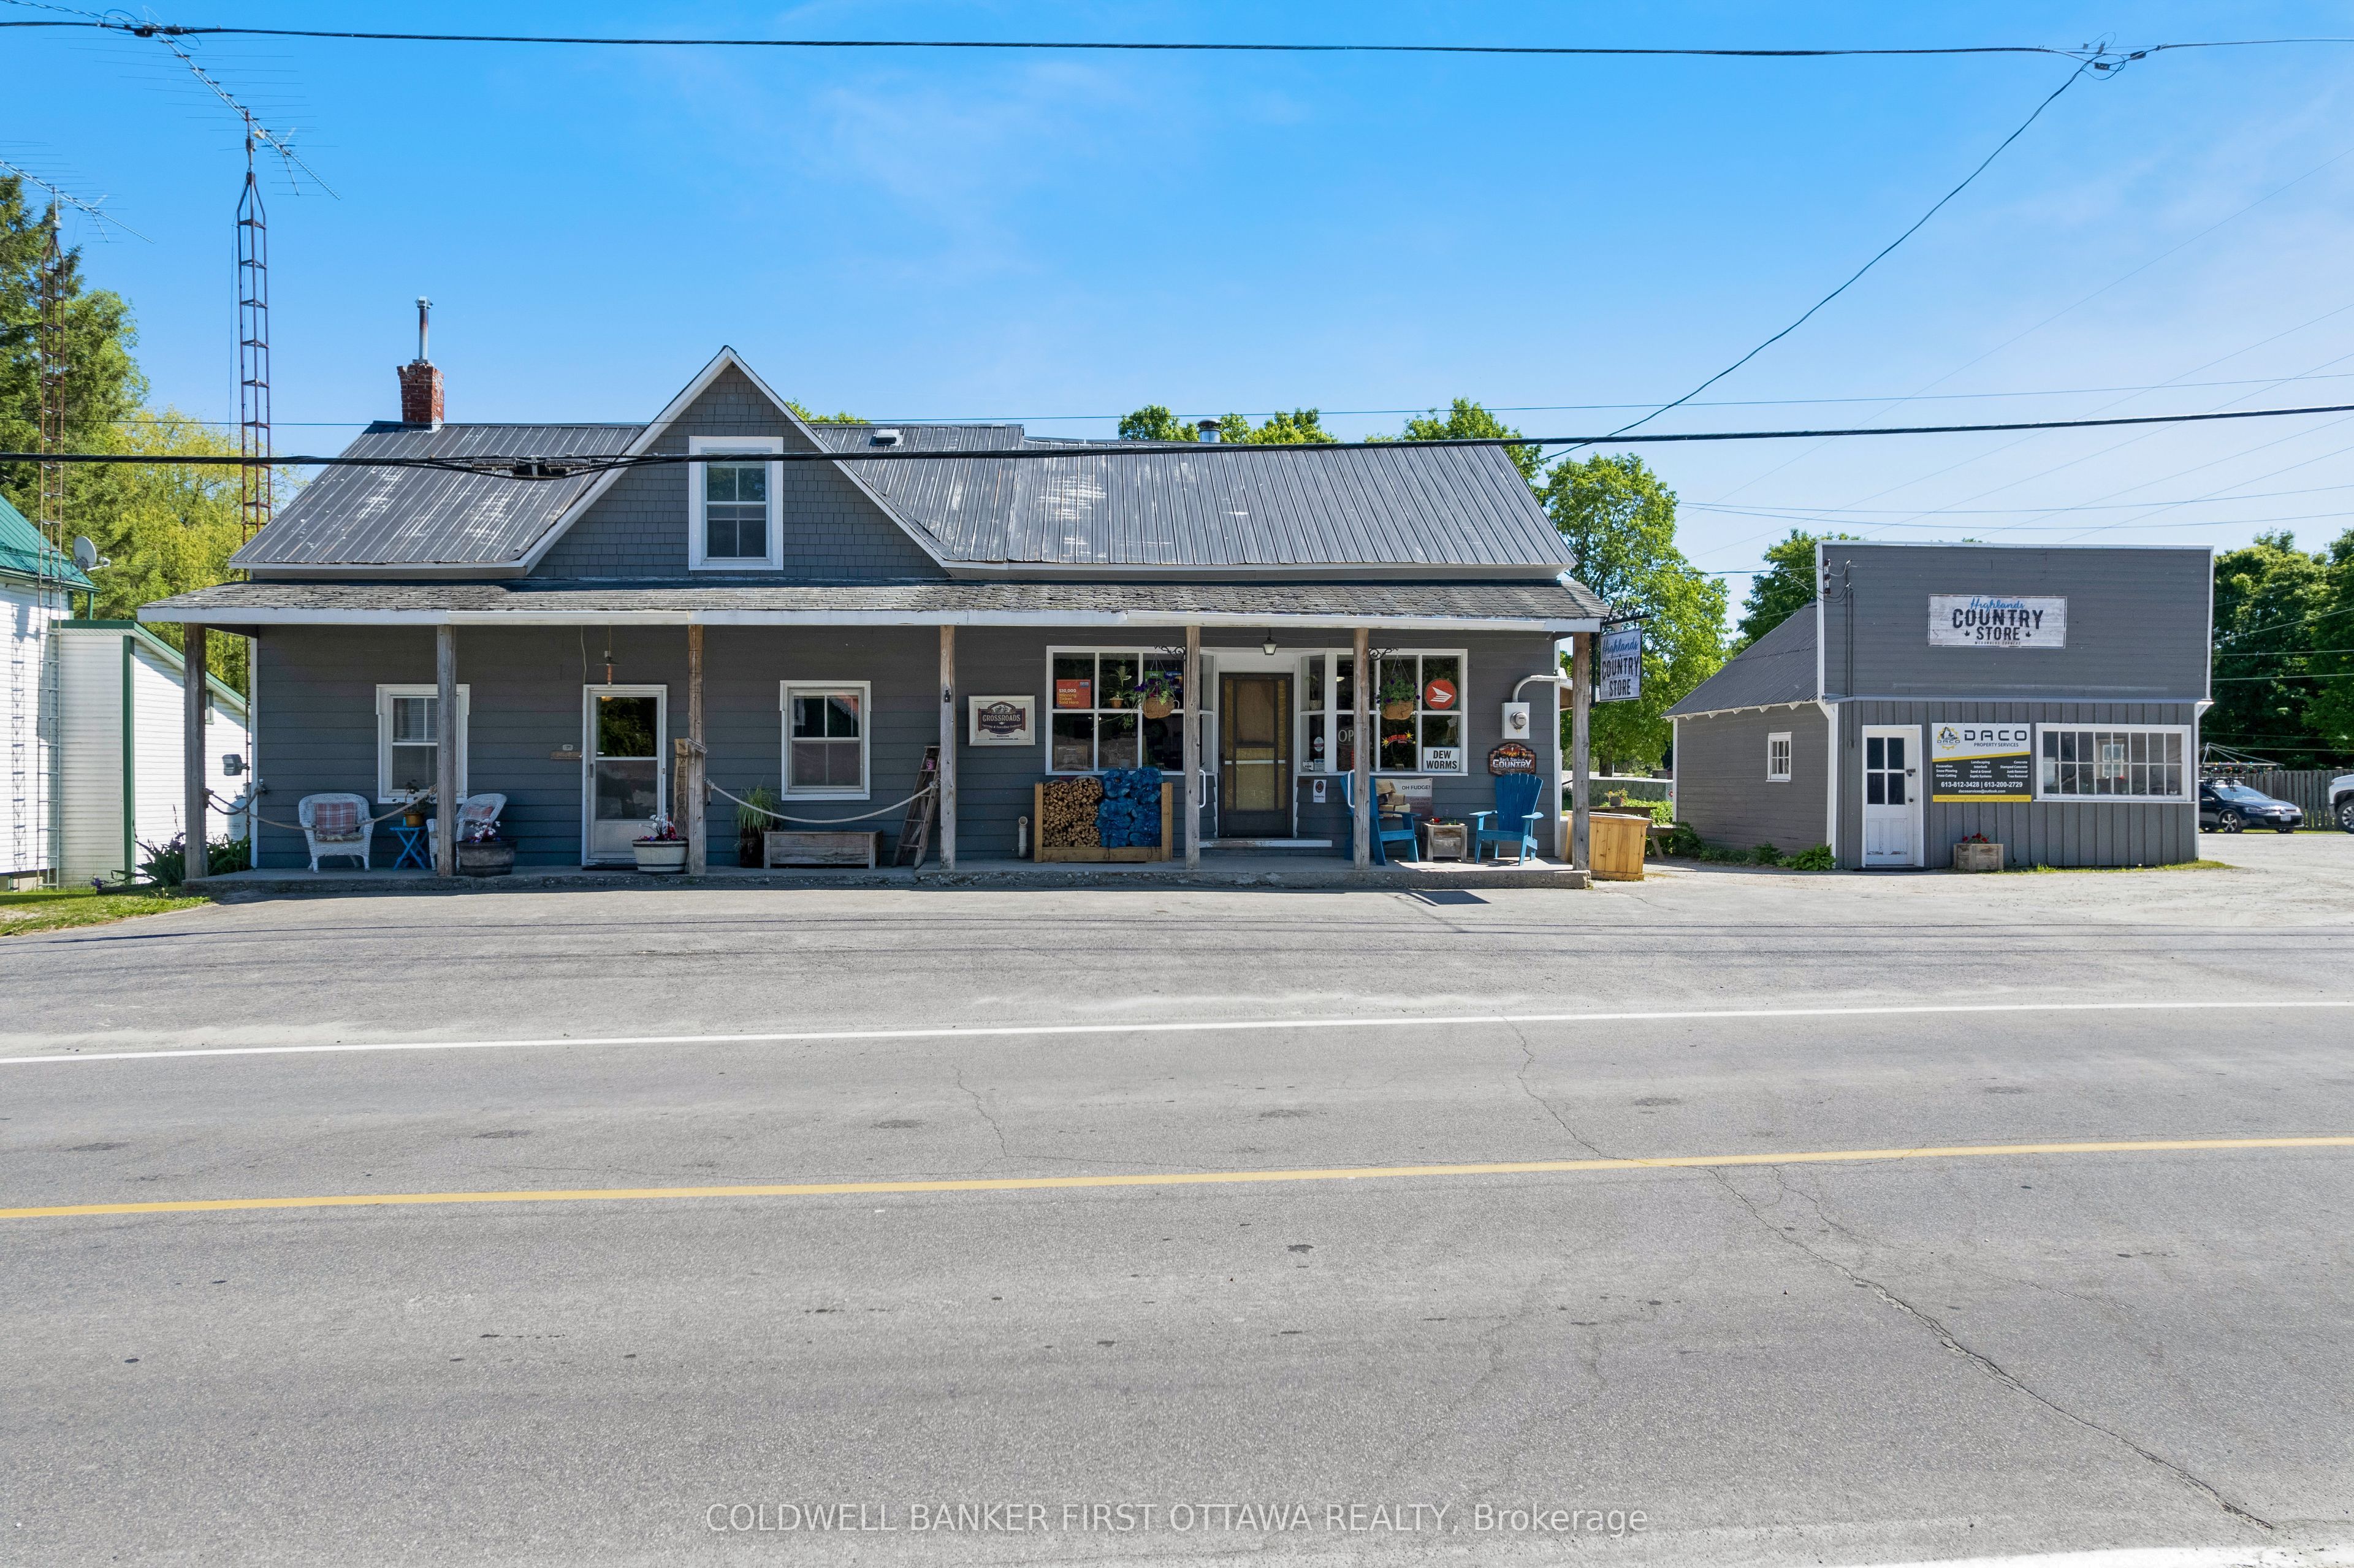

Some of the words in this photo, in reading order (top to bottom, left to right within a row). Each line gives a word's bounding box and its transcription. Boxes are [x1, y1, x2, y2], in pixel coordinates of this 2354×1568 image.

[1970, 598, 2025, 612] Highlands
[1952, 609, 2043, 629] COUNTRY
[1976, 626, 2021, 640] STORE
[1602, 637, 1639, 658] Highlands
[1602, 657, 1639, 680] COUNTRY
[1609, 679, 1631, 696] STORE
[1964, 730, 2027, 741] DACO
[1433, 750, 1452, 759] DEW
[1426, 761, 1458, 769] WORMS
[1493, 759, 1532, 769] COUNTRY
[676, 756, 687, 834] WELCOM
